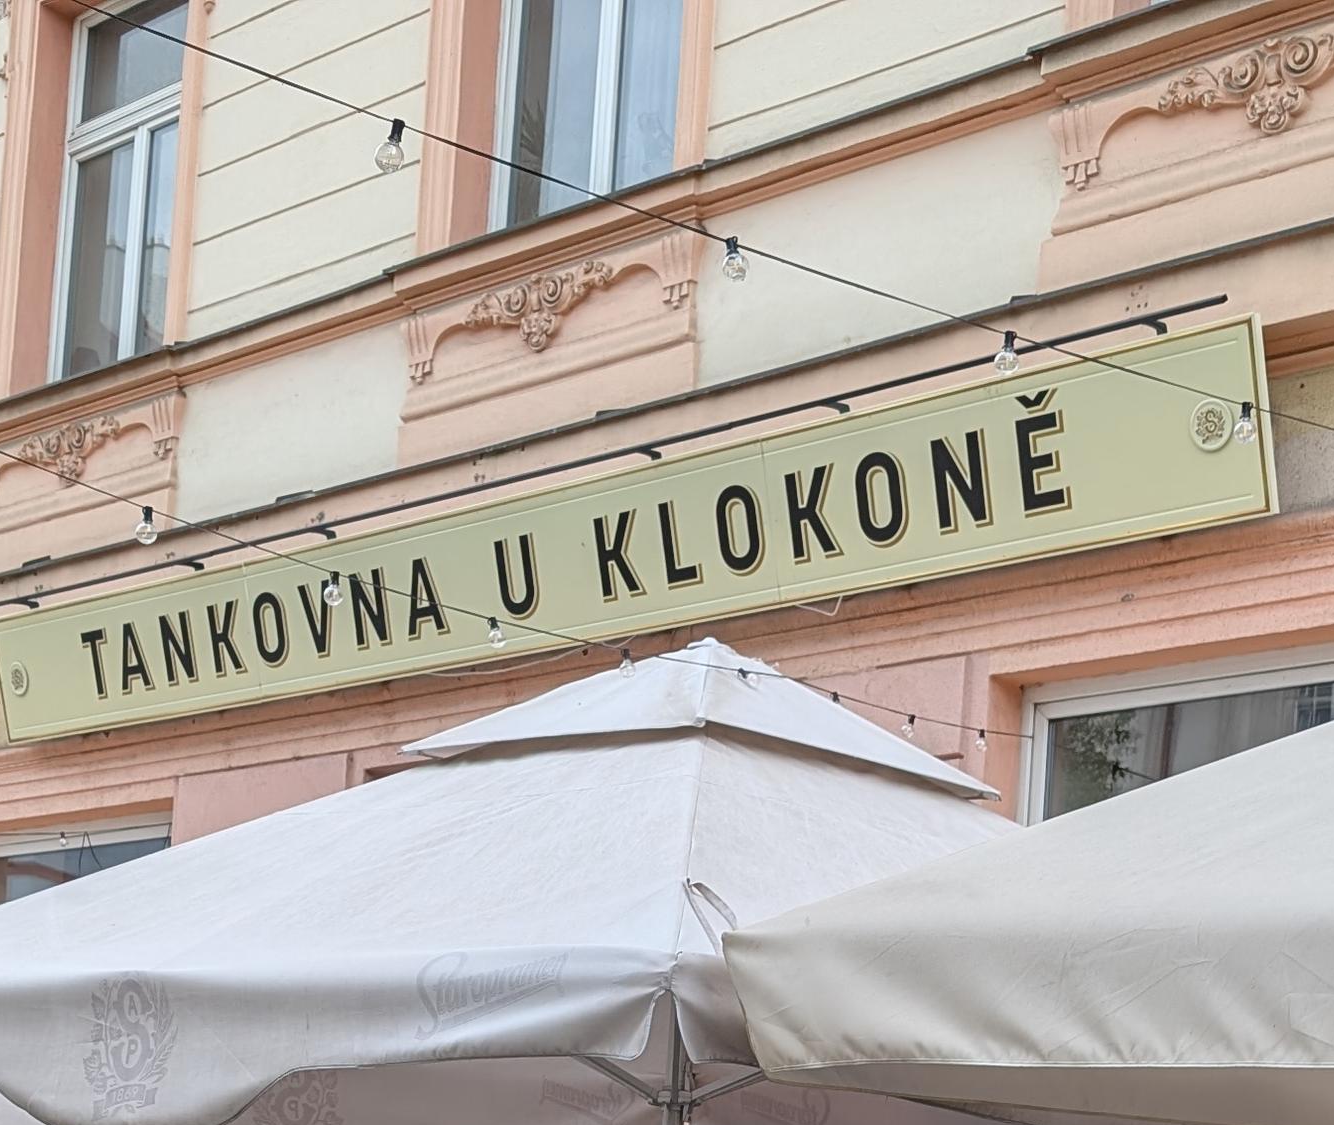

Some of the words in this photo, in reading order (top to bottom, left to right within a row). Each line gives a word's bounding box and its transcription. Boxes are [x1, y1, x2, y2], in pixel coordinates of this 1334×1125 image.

[78, 556, 450, 699] TANKOVNA
[493, 533, 542, 620] U
[594, 387, 1072, 600] KLOKONĚ
